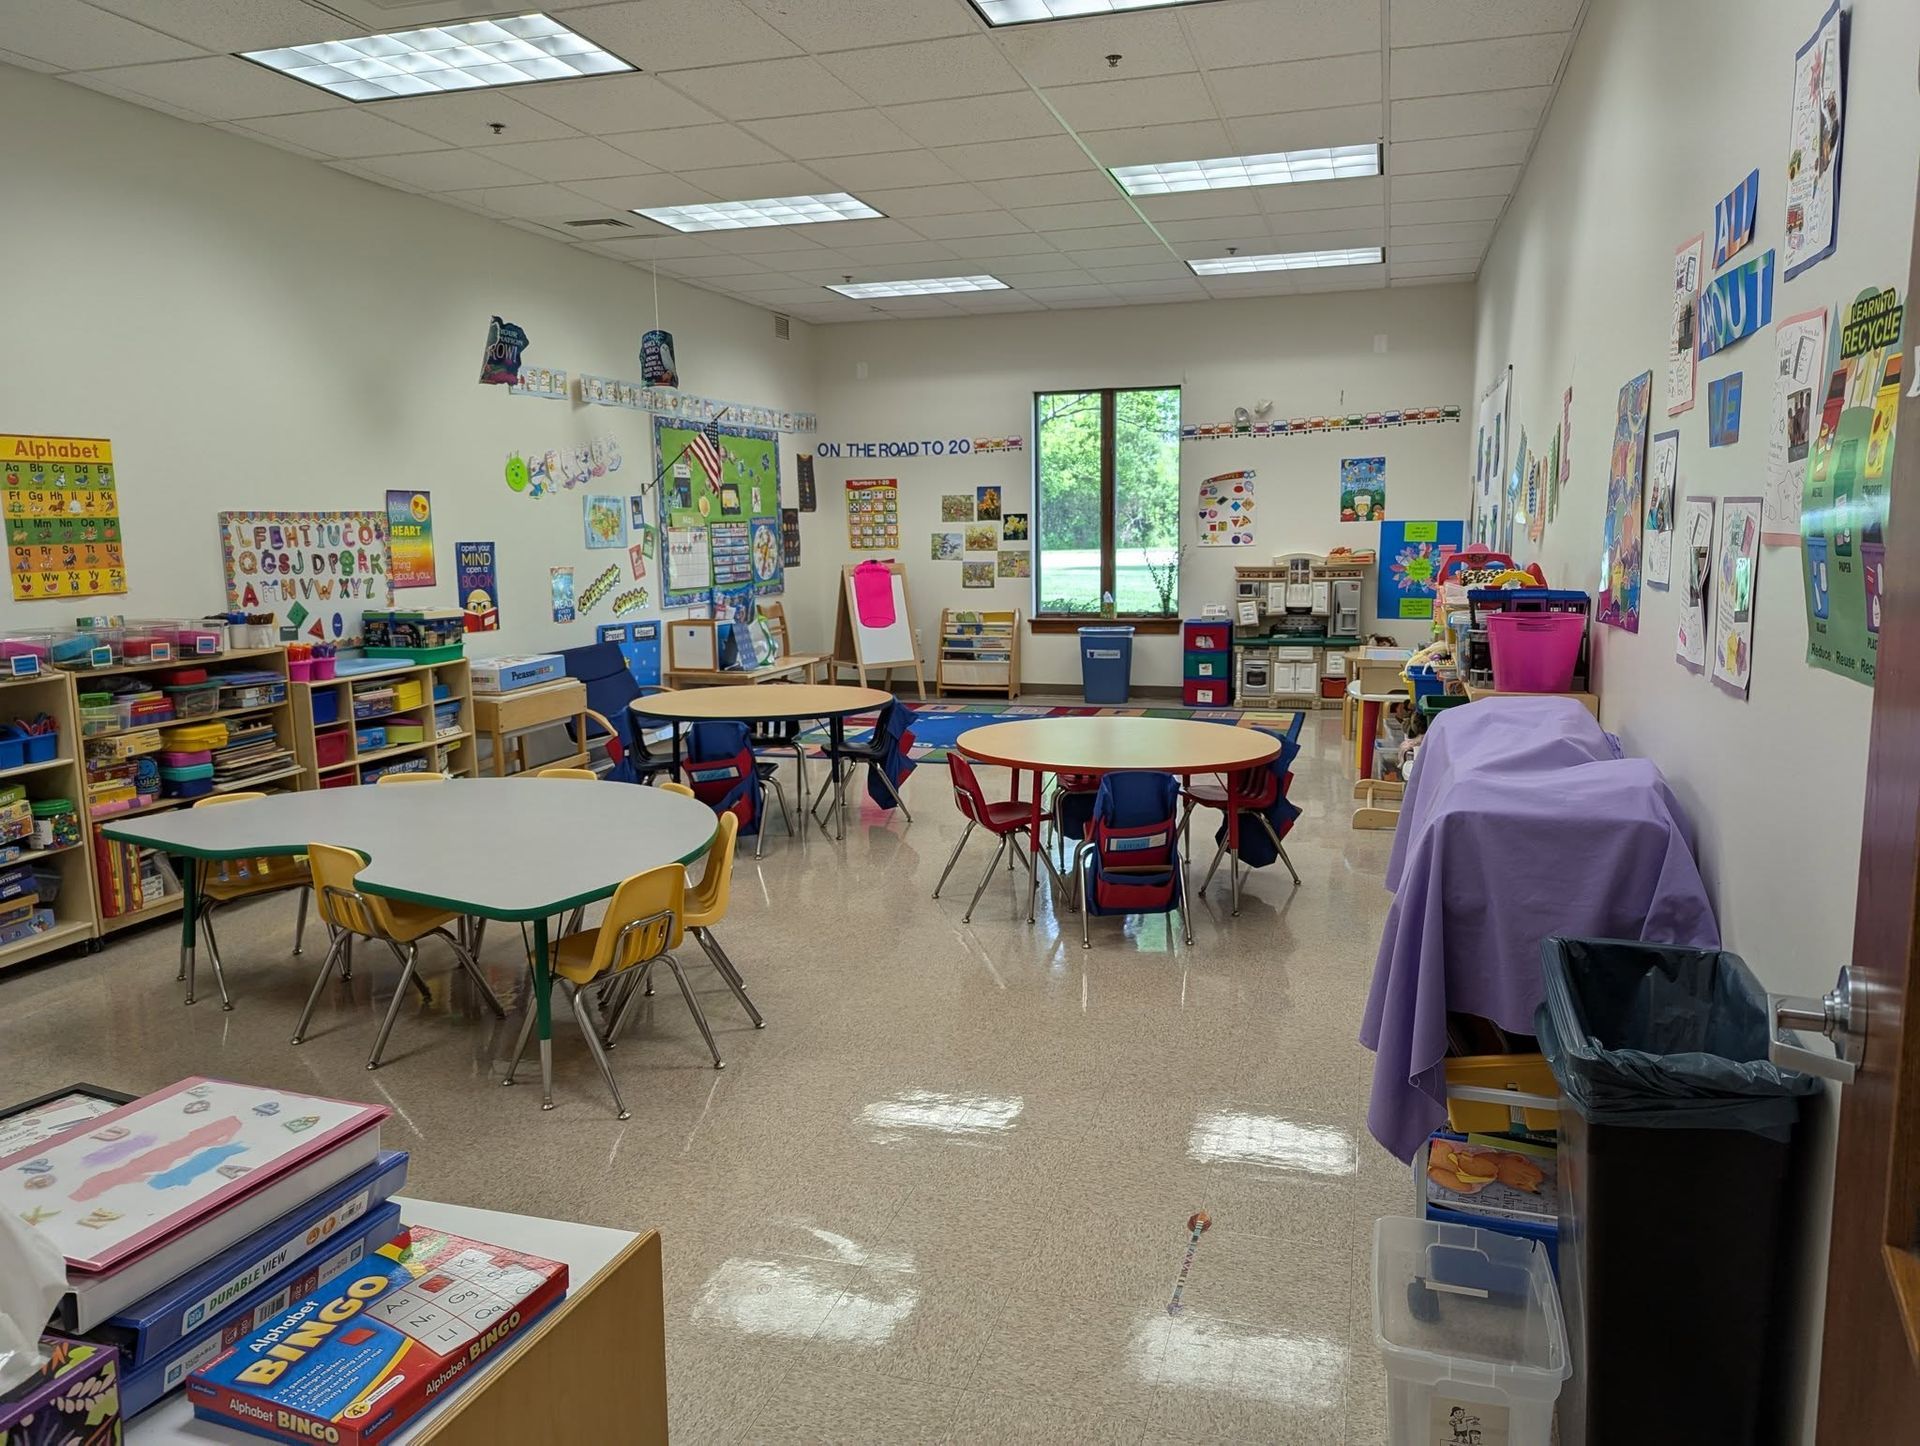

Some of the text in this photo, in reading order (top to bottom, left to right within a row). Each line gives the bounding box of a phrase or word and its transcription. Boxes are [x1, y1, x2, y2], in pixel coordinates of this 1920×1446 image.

[1712, 179, 1750, 269] ALL
[1701, 254, 1769, 353] ABOUT
[1852, 291, 1895, 321] LEARN TO
[1842, 311, 1900, 354] RECYCLE
[14, 440, 100, 459] Alphabet
[818, 439, 970, 457] ON THE ROAD TO 20
[5, 463, 109, 474] Aa Bb Cc Dd Ee
[9, 492, 113, 502] Ff Gg Hh Ii Jj Kk
[13, 519, 115, 529] Ll Mm Nn Oo Pp
[391, 526, 422, 536] HEART
[15, 544, 118, 557] Qq Rr Ss Tt Uu
[460, 545, 491, 553] open your
[461, 553, 492, 566] MIND
[18, 569, 121, 583] Vv Ww Xx Yy Zz
[462, 575, 494, 588] BOOK
[554, 600, 574, 609] READ
[557, 613, 572, 623] DAY
[1811, 643, 1831, 661] Reduce
[1836, 650, 1855, 669] Reuse
[209, 1269, 262, 1311] DURABLE
[262, 1250, 288, 1277] VIEW
[448, 1289, 479, 1304] Gg
[386, 1299, 410, 1314] Aa
[474, 1304, 510, 1320] Qq
[249, 1301, 320, 1353] Alphabet
[409, 1313, 436, 1328] Nn
[234, 1275, 389, 1385] BINGO
[438, 1329, 458, 1342] Ll
[426, 1357, 467, 1396] Alphabet
[469, 1311, 521, 1362] BINGO
[289, 1376, 307, 1390] game
[307, 1363, 324, 1377] cards
[301, 1375, 320, 1391] bingo
[320, 1358, 345, 1376] markers
[307, 1348, 383, 1405] Calling card reference mat
[308, 1374, 335, 1395] alphabet
[335, 1360, 356, 1376] calling
[355, 1348, 371, 1361] cards
[317, 1389, 342, 1408] Activity
[341, 1376, 360, 1391] guide
[229, 1399, 340, 1444] Alphabet BINGO
